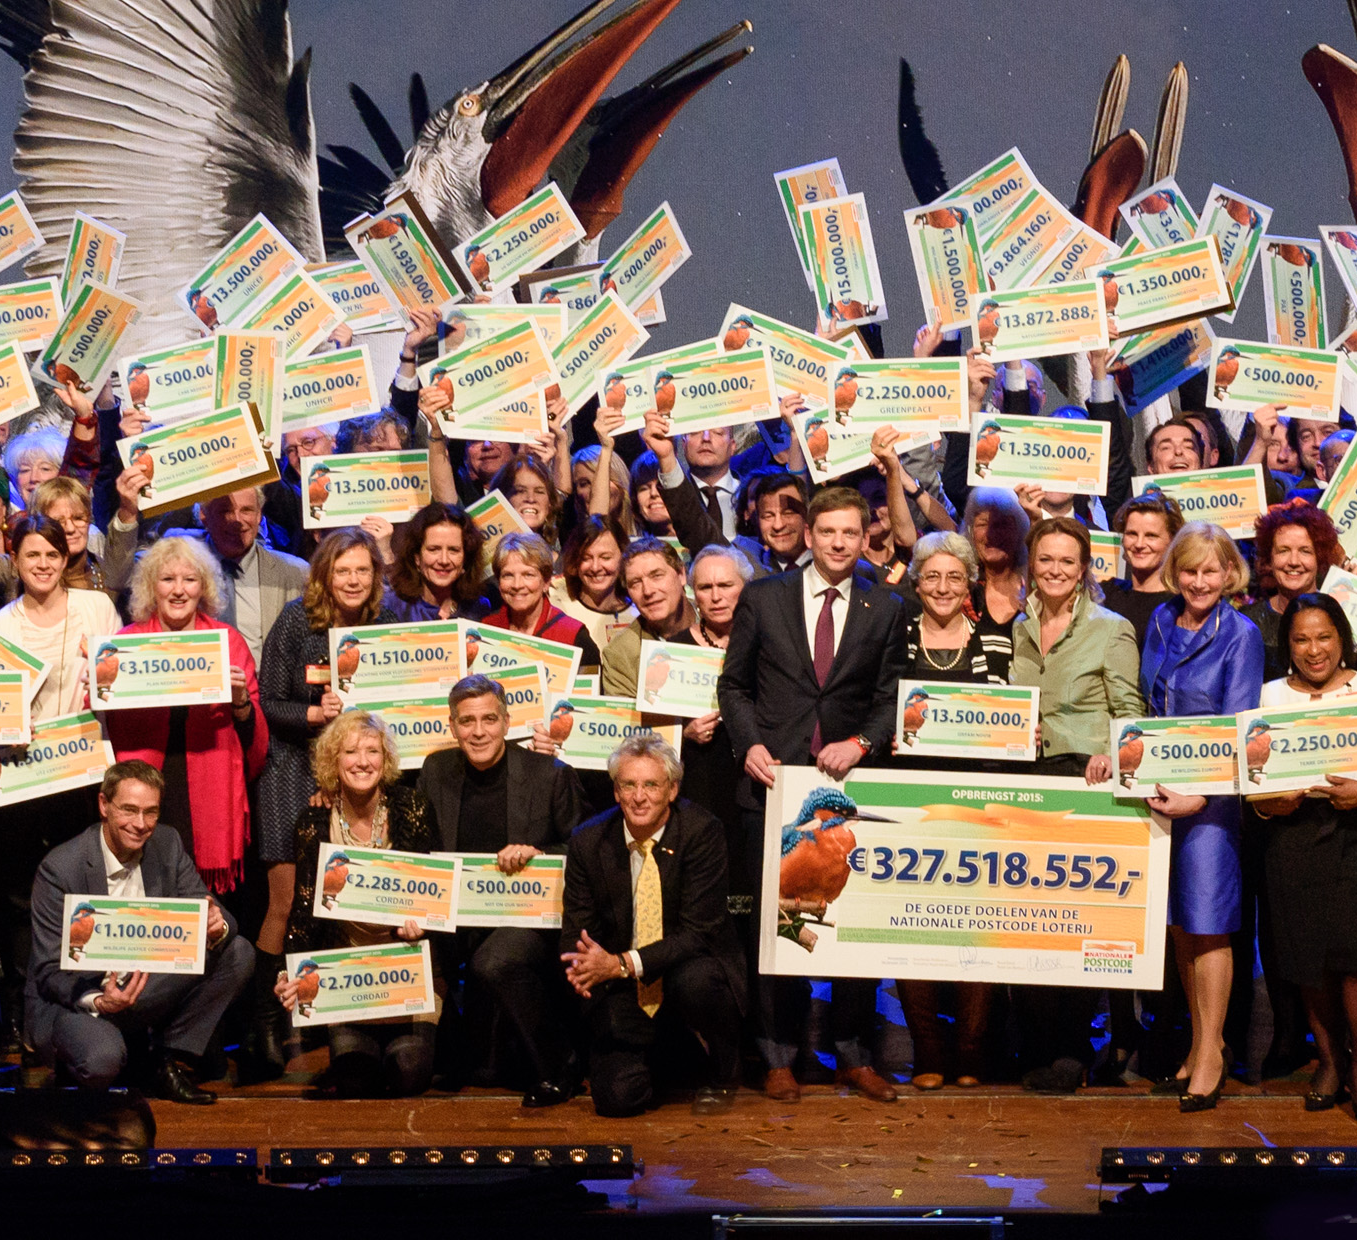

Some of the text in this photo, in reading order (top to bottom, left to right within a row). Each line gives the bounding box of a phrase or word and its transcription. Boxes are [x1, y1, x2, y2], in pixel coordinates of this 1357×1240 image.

[485, 210, 562, 262] €2.250.000,-
[989, 208, 1053, 276] €9.864.160,-
[618, 236, 668, 286] €500.000,-
[826, 206, 852, 304] €15.000.000,-
[204, 238, 280, 308] €13.500.000,-
[388, 234, 436, 305] €1.930.000,-
[944, 228, 968, 315] €1.500.000,-
[1118, 266, 1208, 295] €1.350.000,-
[242, 276, 265, 298] UNICEF
[994, 306, 1098, 328] €13.872.888,-
[1291, 270, 1306, 346] €500.000,-
[69, 304, 113, 364] €500.000,-
[559, 323, 618, 380] €500.000,-
[458, 350, 531, 387] €900.000,-
[1244, 367, 1322, 389] €500.000,-
[681, 376, 756, 399] €900.000,-
[857, 384, 955, 401] €2.250.000,-
[305, 396, 333, 408] UNHCR
[880, 406, 932, 414] GREENPEACE
[158, 435, 238, 467] €500.000,-
[999, 441, 1095, 462] €1.350.000,-
[324, 477, 429, 494] €13.500.000,-
[119, 656, 215, 676] €3.150.000,-
[359, 648, 453, 667] €1.510.000,-
[921, 708, 1031, 728] €13.500.000,-
[951, 789, 1044, 803] OPBRENGST 2015:
[346, 873, 447, 899] €2.285.000,-
[467, 879, 551, 896] €500.000,-
[375, 895, 414, 907] CORDAID
[905, 904, 1079, 919] DE GOEDE DOELEN VAN DE
[94, 922, 192, 943] €1.100.000,-
[889, 916, 1093, 935] NATIONALE POSTCODE LOTERIJ
[1083, 958, 1133, 969] POSTCODE
[1089, 951, 1129, 960] NATIONALE
[318, 969, 420, 992] €2.700.000,-
[351, 991, 390, 1002] CORDAID
